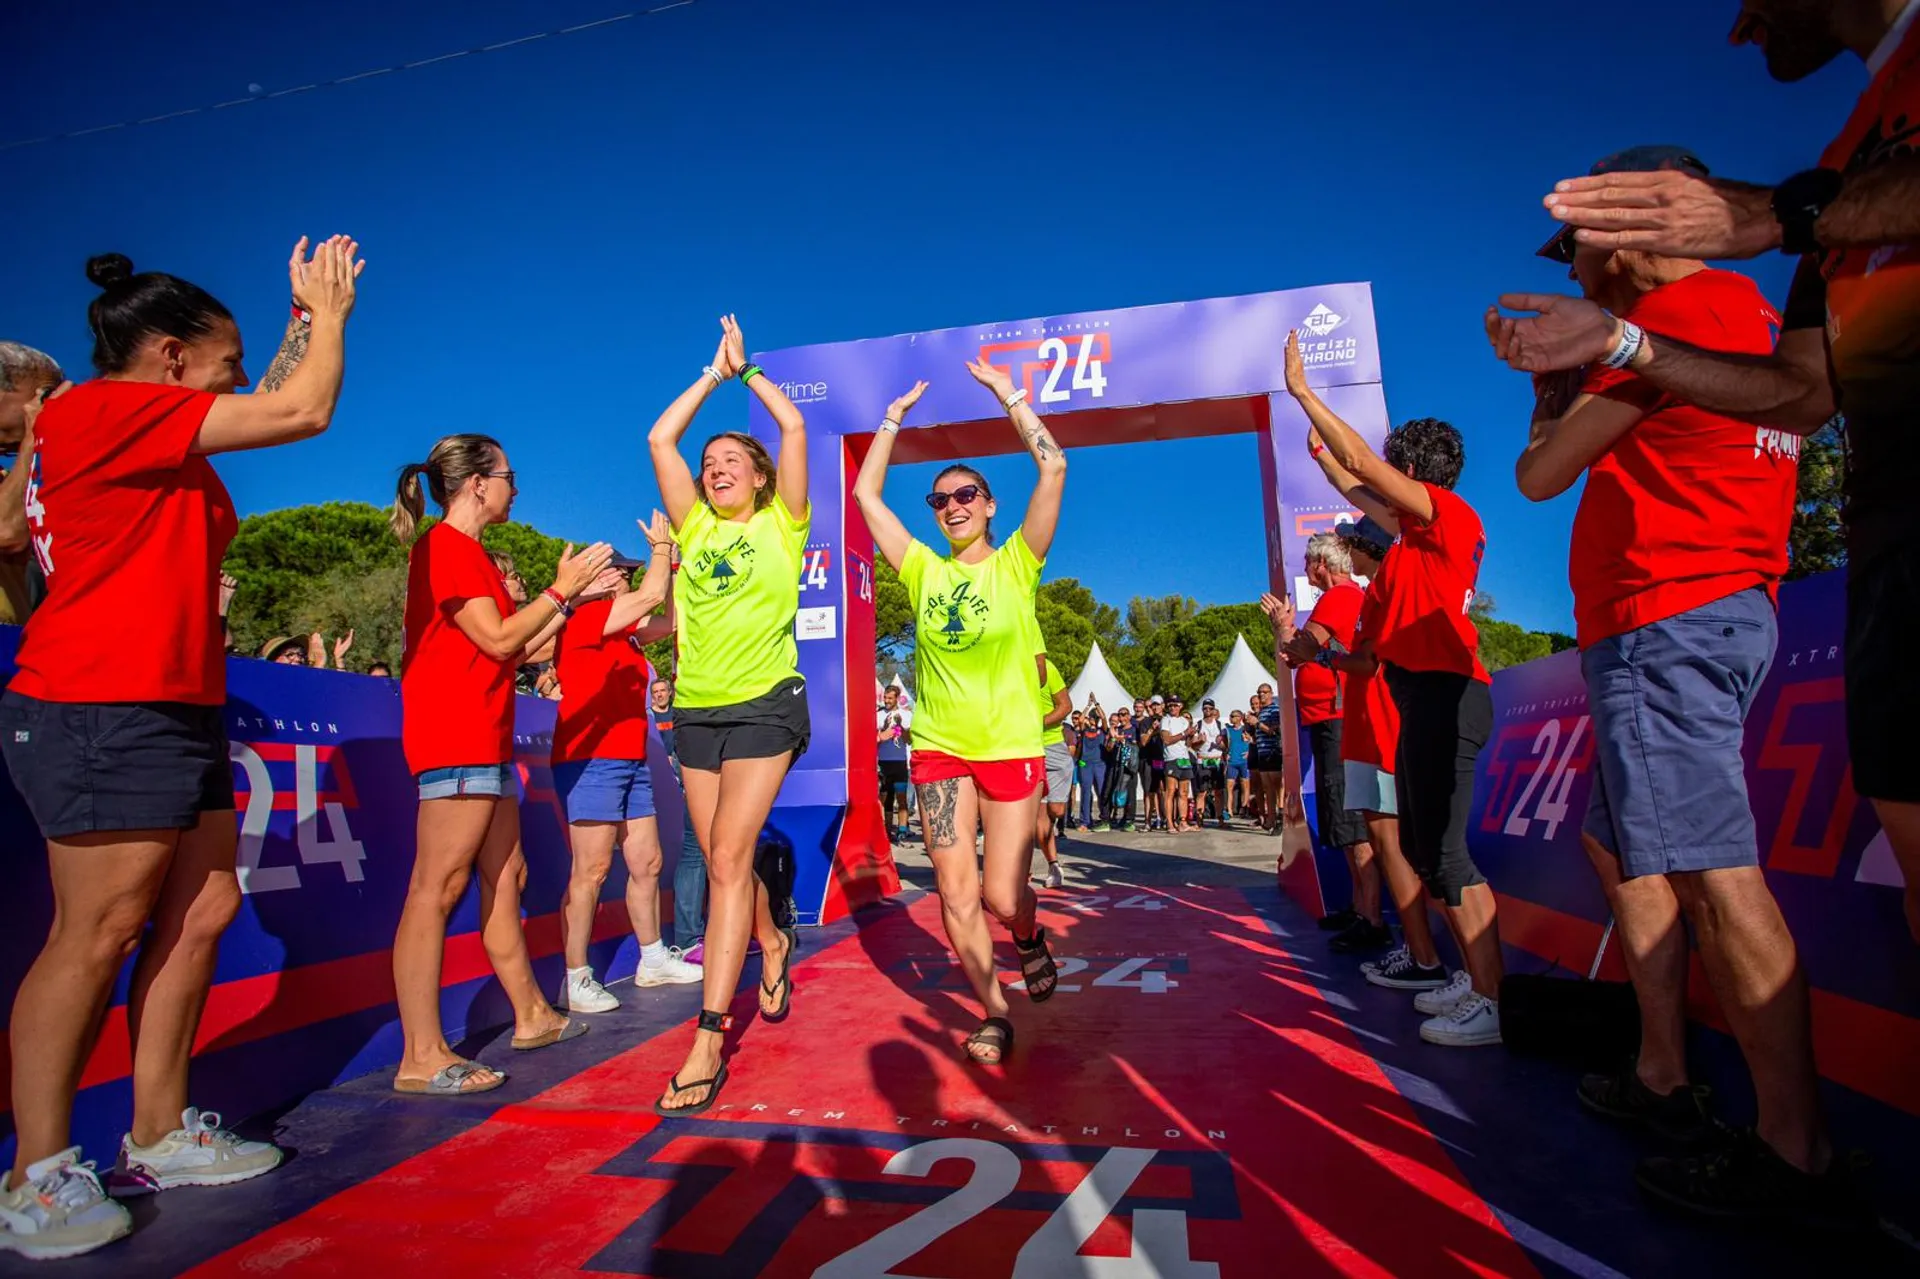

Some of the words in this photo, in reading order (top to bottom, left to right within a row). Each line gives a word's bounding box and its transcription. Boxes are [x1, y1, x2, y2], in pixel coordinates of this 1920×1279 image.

[1299, 348, 1357, 365] HRONO
[1787, 645, 1839, 667] XTR
[236, 716, 339, 735] ATHLON
[718, 1102, 846, 1121] TREM
[895, 1115, 1228, 1141] TRIATHLON
